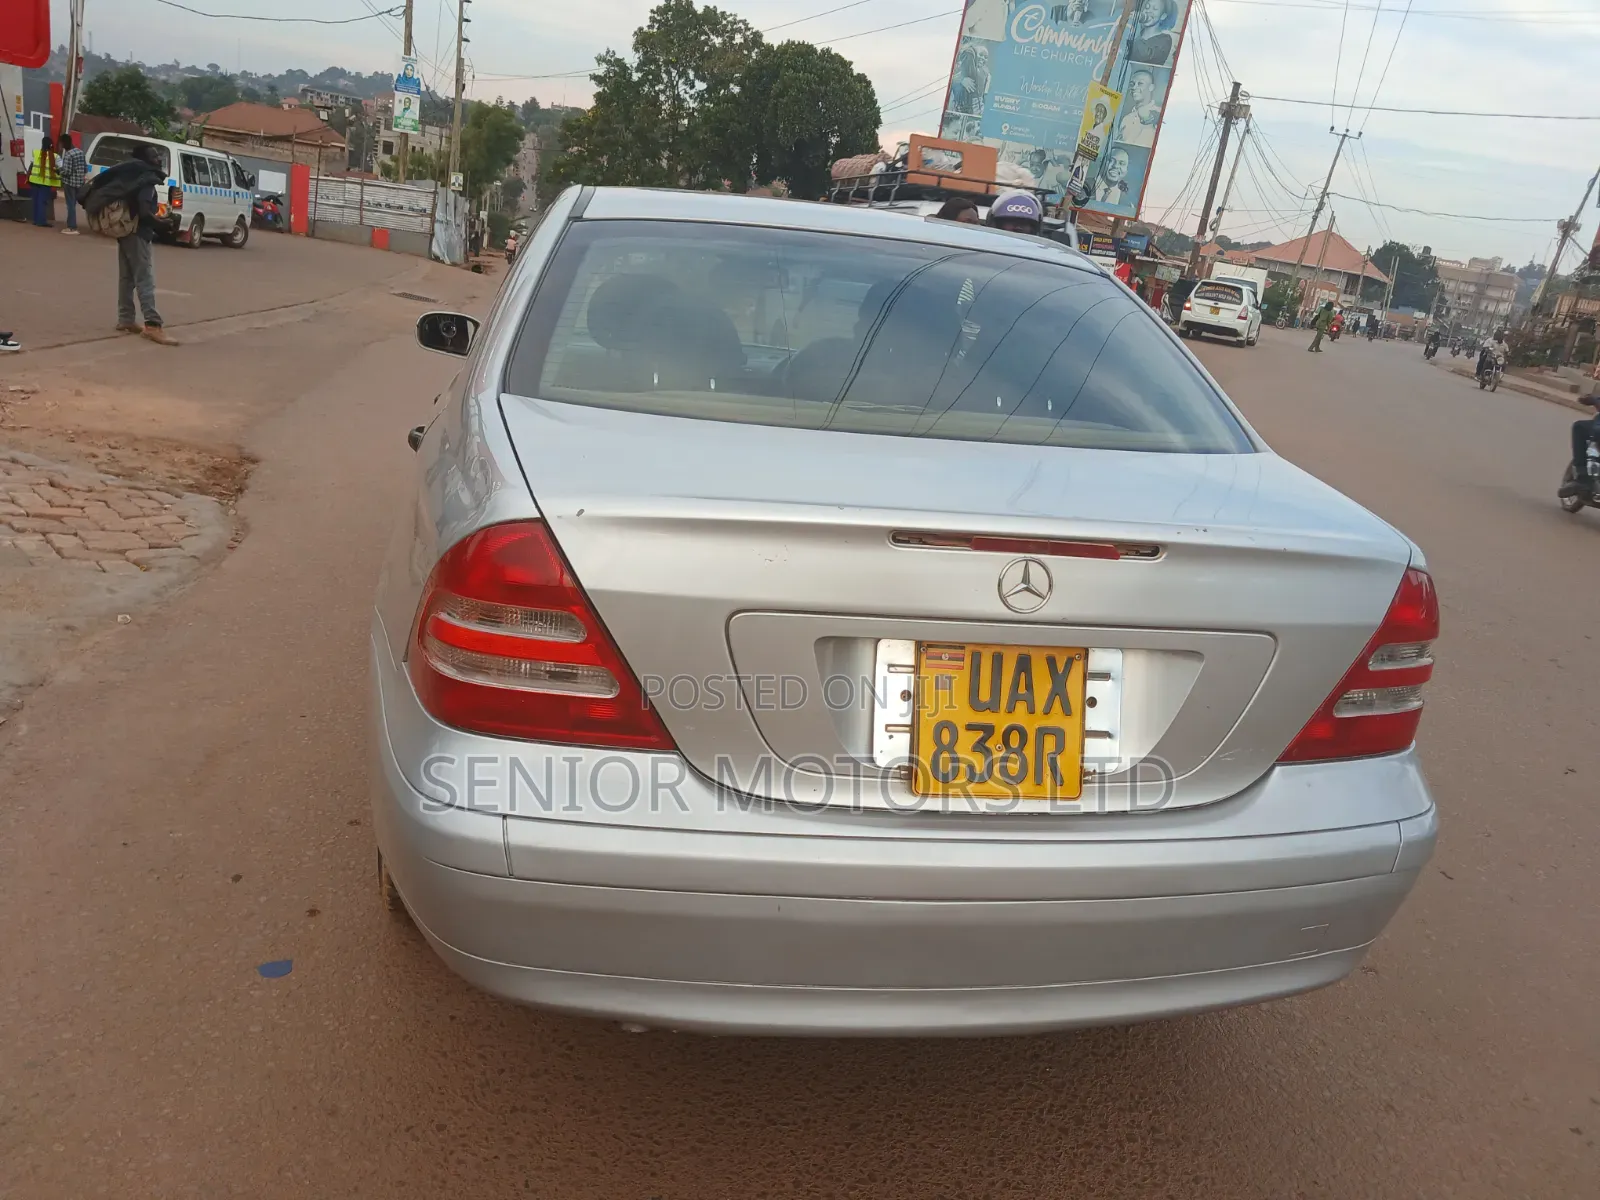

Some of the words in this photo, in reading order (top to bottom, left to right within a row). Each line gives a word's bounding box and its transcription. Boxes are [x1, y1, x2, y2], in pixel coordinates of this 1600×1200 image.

[1013, 44, 1038, 57] LIFE
[1040, 48, 1094, 66] CHURCH
[1006, 203, 1033, 215] GOGO
[968, 651, 1075, 716] UAX
[930, 719, 1066, 787] 838R
